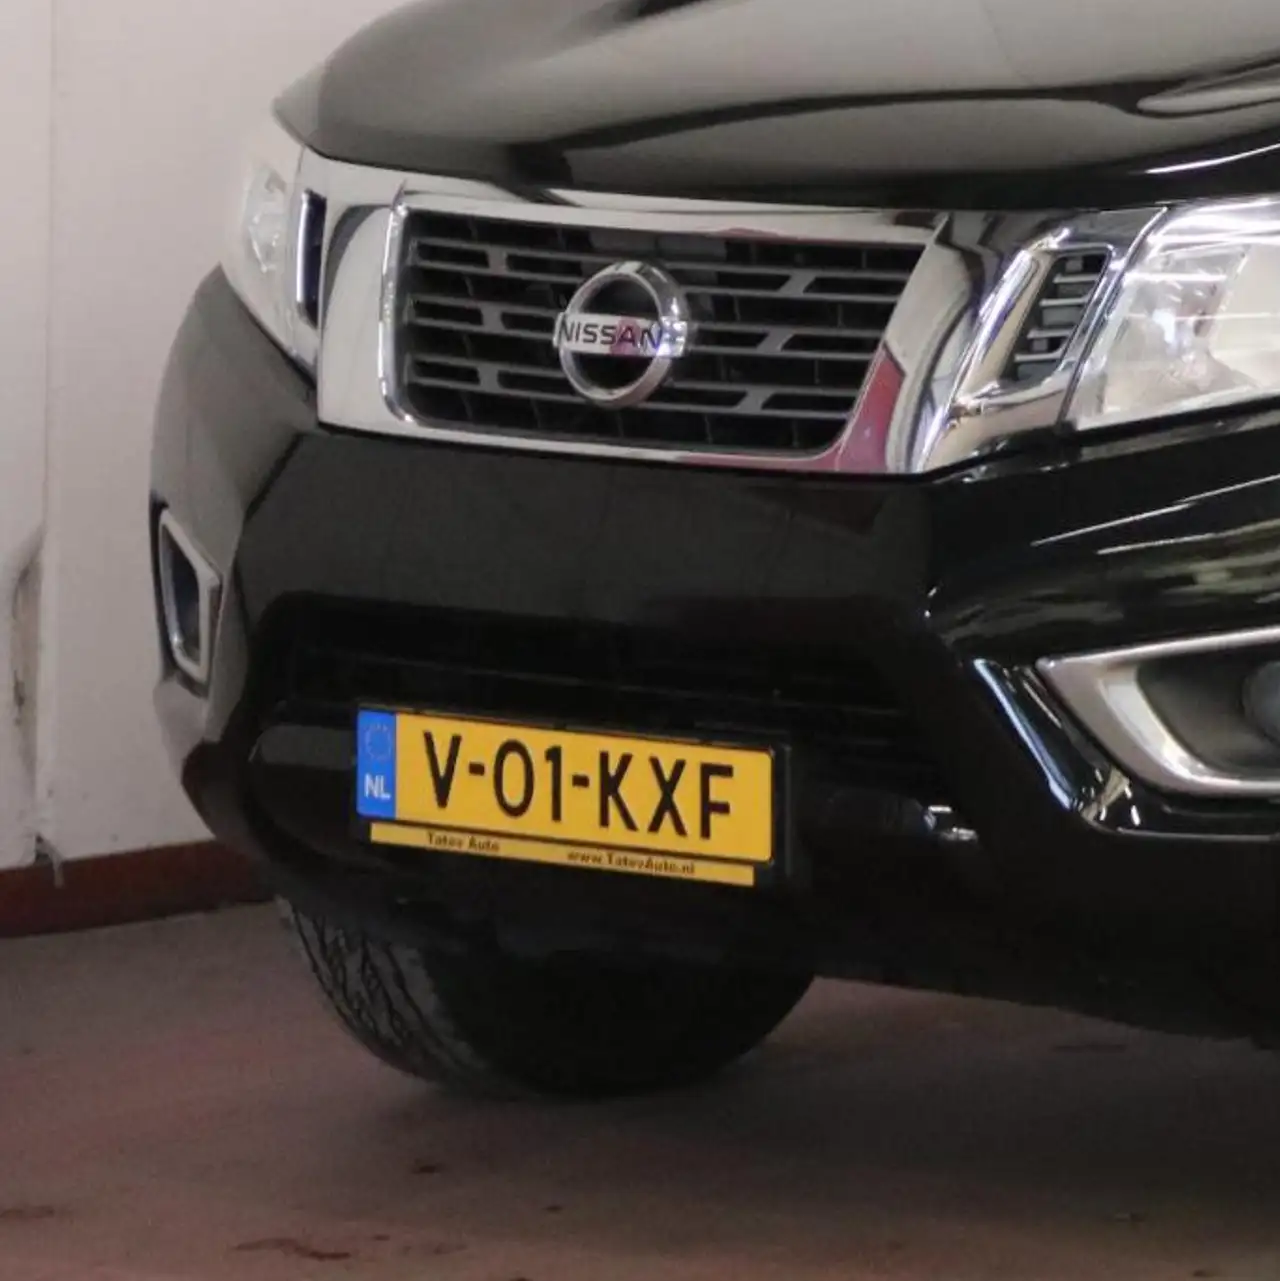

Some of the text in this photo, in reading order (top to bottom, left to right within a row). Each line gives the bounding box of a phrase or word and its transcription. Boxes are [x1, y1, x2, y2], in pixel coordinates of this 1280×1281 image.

[557, 317, 663, 350] NISSAN
[364, 773, 391, 800] NL
[423, 730, 735, 839] V-01-KXF
